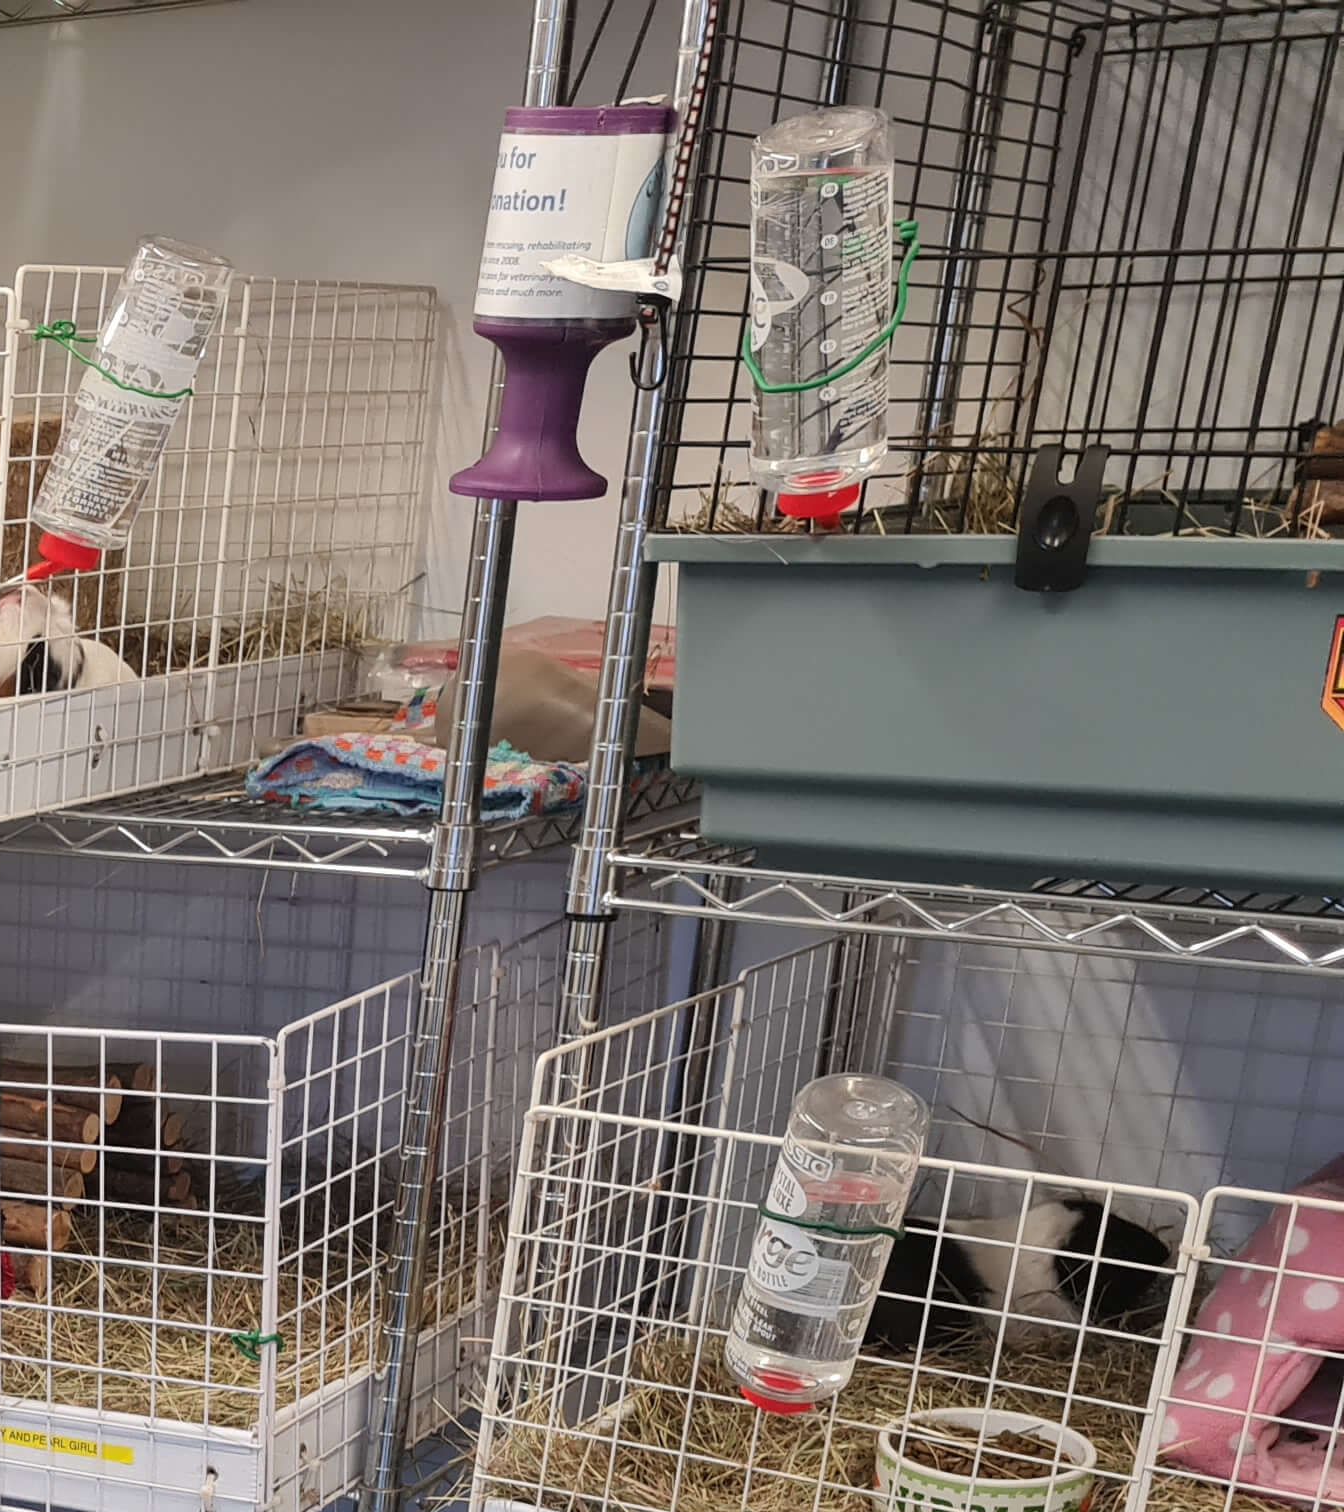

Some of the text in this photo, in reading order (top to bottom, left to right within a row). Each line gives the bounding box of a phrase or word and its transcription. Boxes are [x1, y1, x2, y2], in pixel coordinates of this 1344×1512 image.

[509, 145, 537, 169] for
[527, 240, 591, 252] rehabilitating
[785, 1135, 829, 1177] SSIC
[9, 1430, 31, 1442] AND
